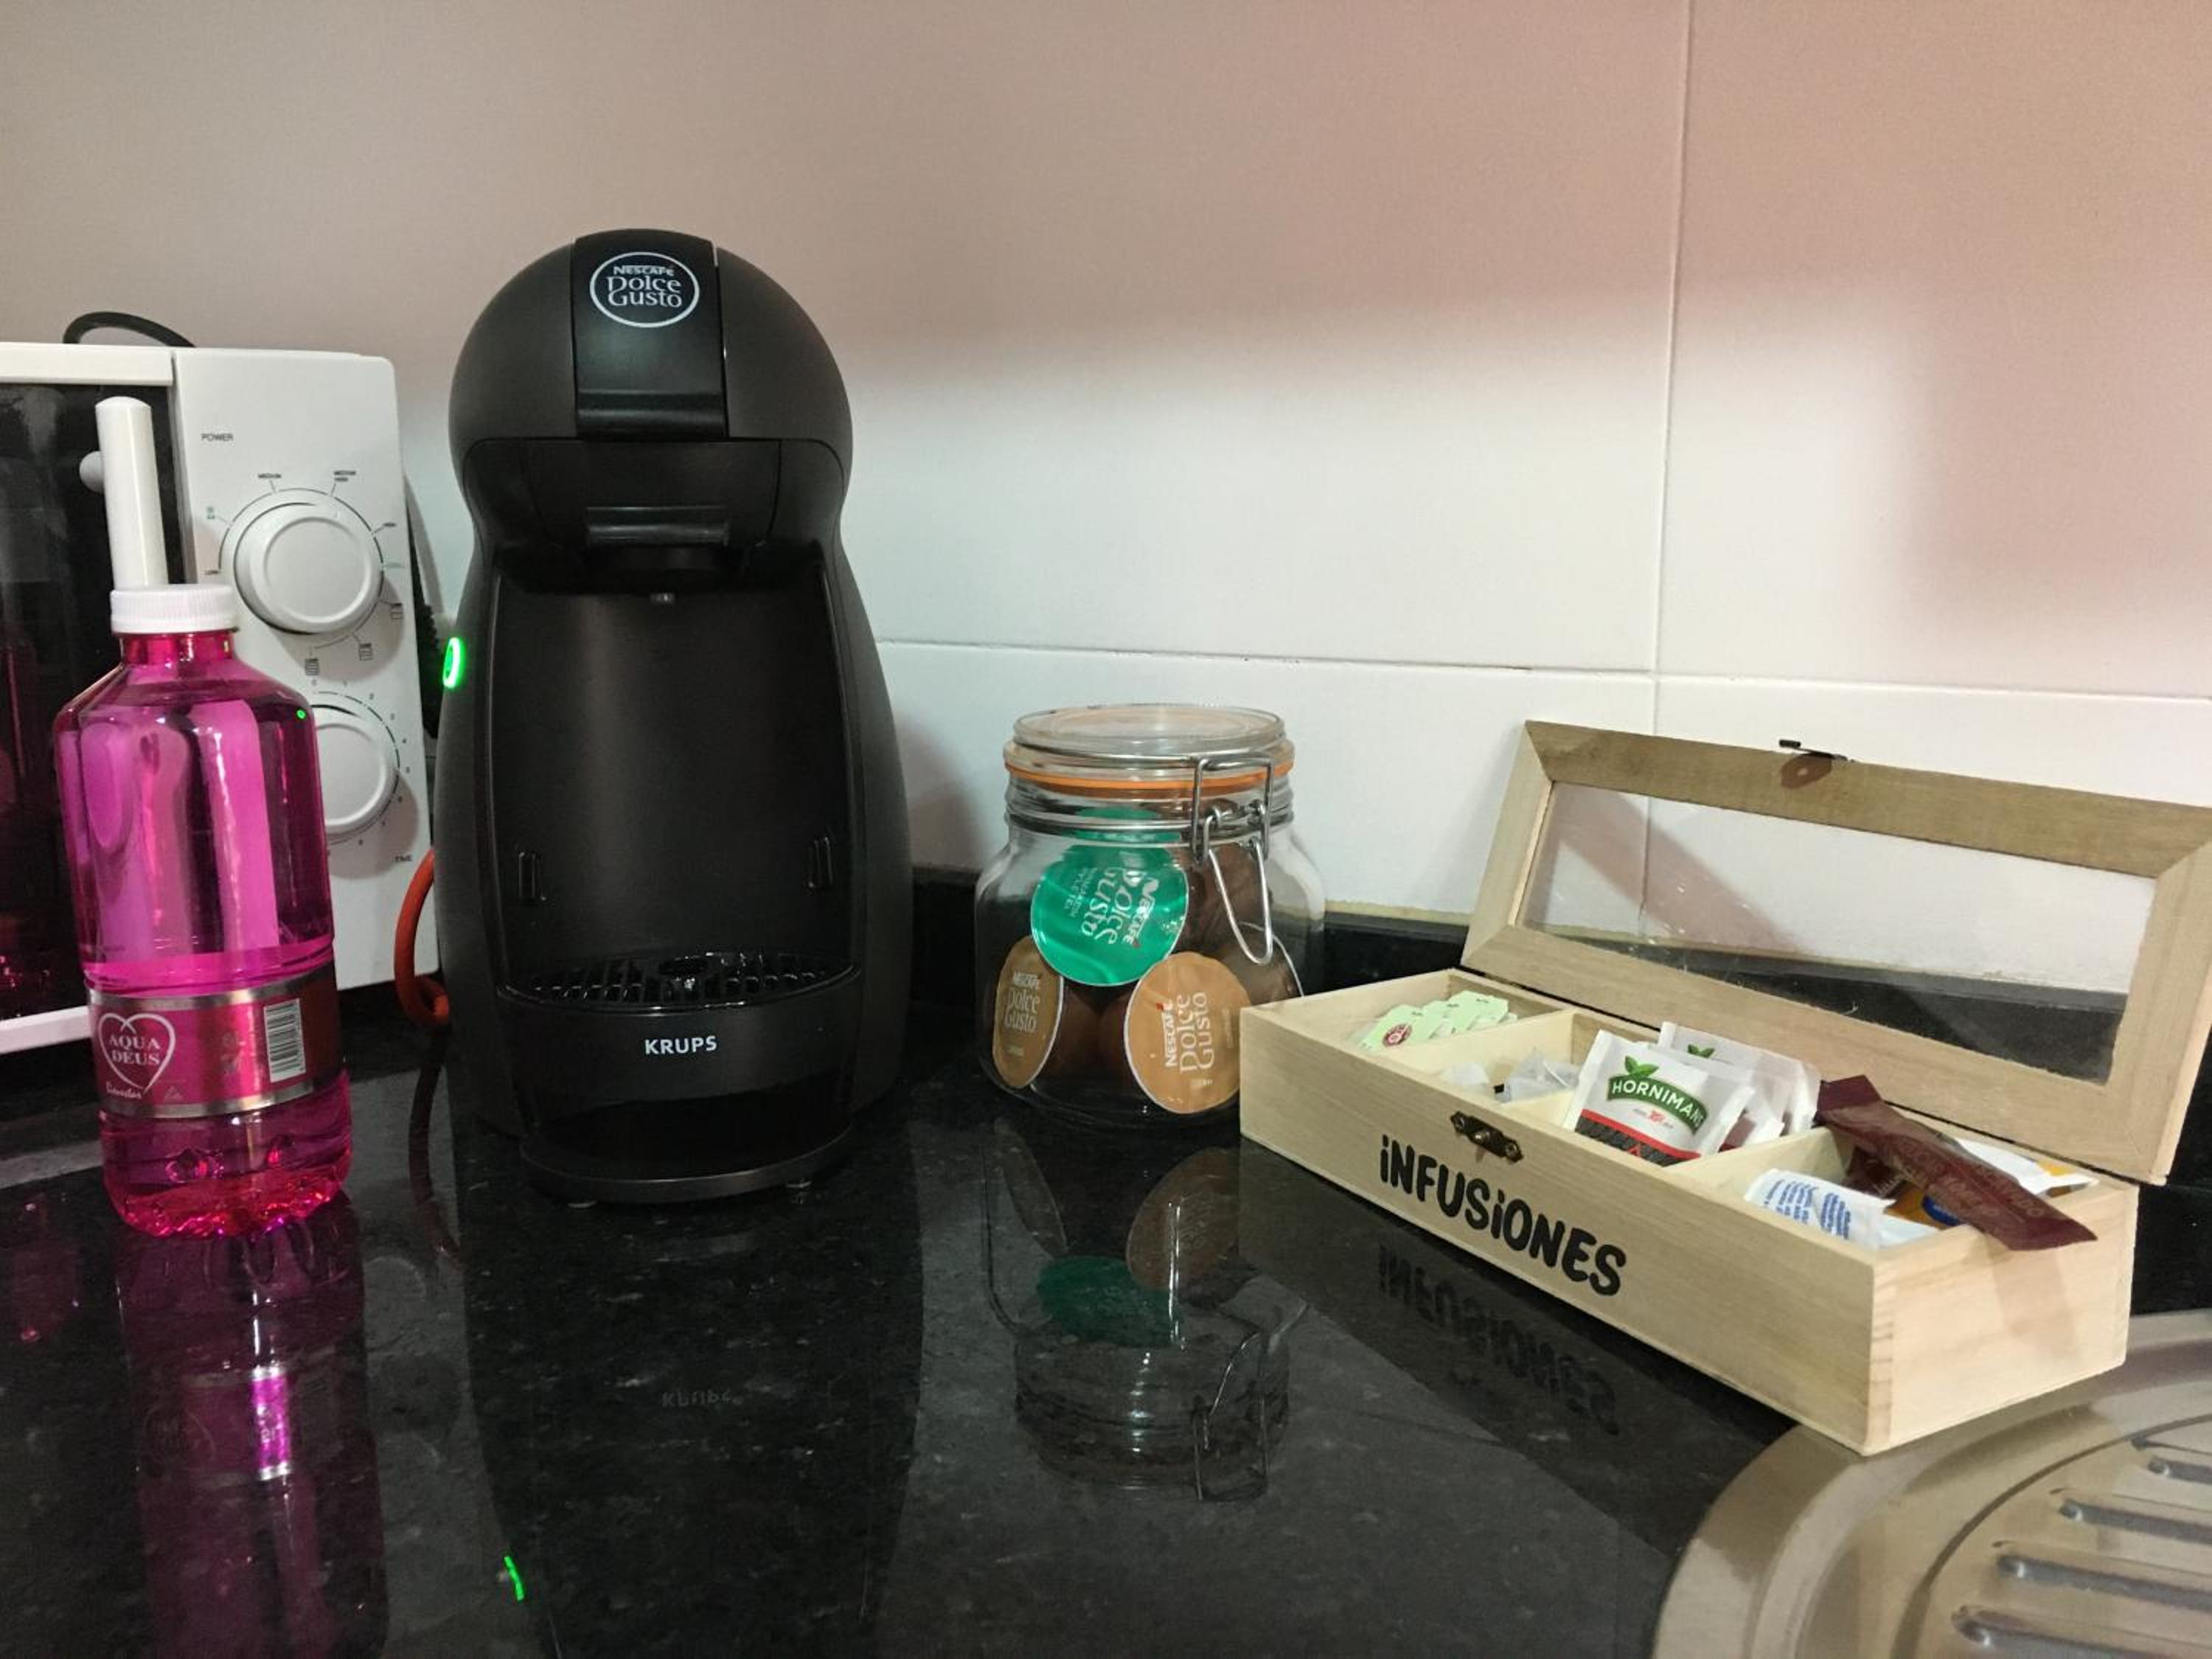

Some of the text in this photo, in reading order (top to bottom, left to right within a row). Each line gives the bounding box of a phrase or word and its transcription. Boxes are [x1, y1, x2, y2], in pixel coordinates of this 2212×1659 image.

[606, 275, 681, 293] Dolce
[608, 291, 683, 307] Gusto
[201, 433, 234, 442] POWER
[1176, 994, 1197, 1072] Dolce
[1192, 992, 1214, 1069] Gusto
[109, 1034, 161, 1051] AQUA
[644, 1035, 717, 1054] KRUPS
[111, 1049, 161, 1066] DEUS
